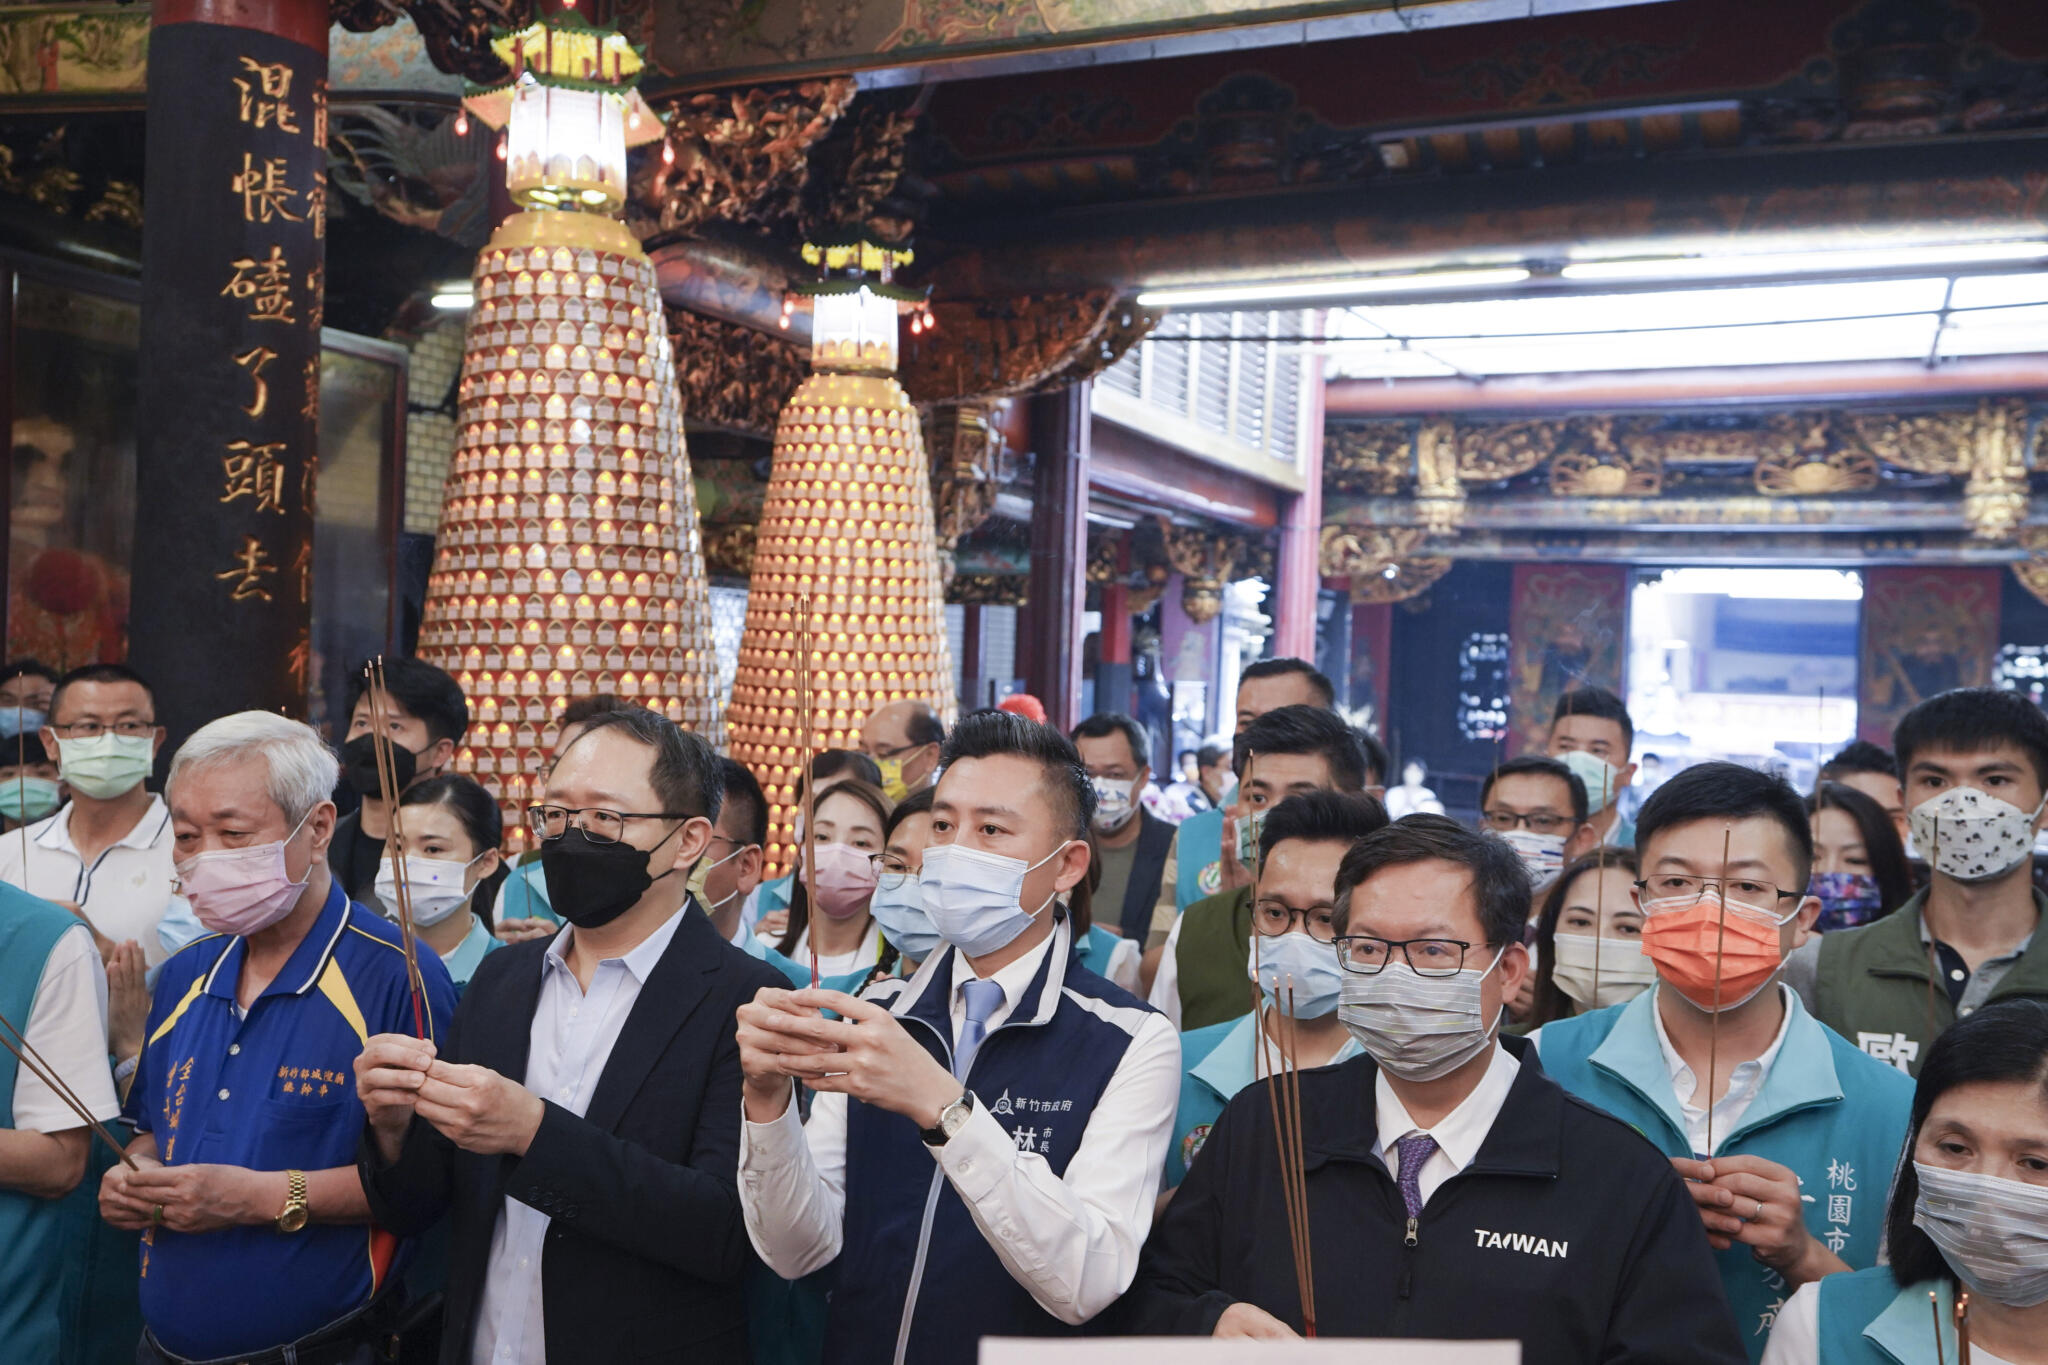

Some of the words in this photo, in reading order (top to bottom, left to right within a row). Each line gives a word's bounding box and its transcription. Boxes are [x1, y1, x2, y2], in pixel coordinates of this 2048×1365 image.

[216, 55, 304, 602] 混帳磕了頭去
[1015, 1097, 1073, 1112] 新竹市政府
[1012, 1125, 1037, 1152] 林
[1040, 1127, 1053, 1153] 市長
[1824, 1157, 1857, 1254] 桃園市
[1474, 1228, 1569, 1259] TAIWAN
